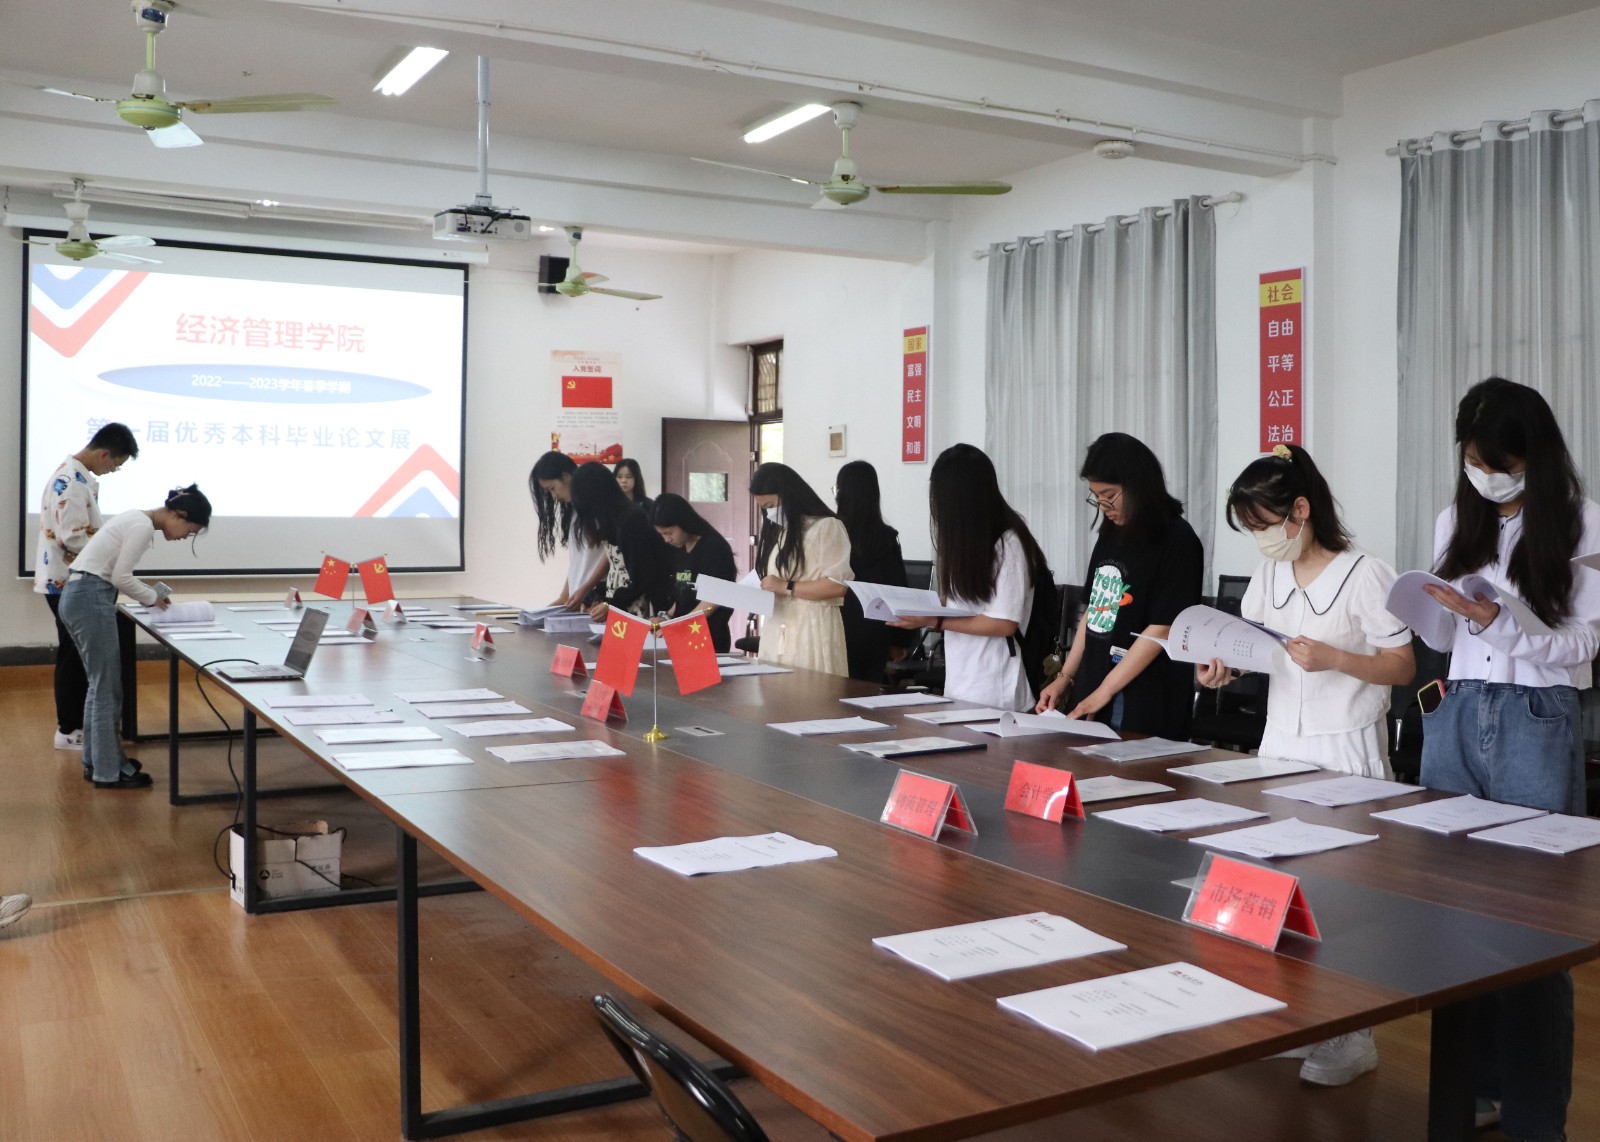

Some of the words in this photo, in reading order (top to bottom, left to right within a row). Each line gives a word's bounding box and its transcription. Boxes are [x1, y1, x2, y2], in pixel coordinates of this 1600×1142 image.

[1267, 283, 1294, 303] 社会
[175, 313, 366, 353] 经济管理学院
[1267, 318, 1294, 338] 自由
[907, 338, 922, 351] 国家
[907, 363, 922, 377] 富强
[1267, 353, 1294, 373] 平等
[907, 389, 922, 403] 民主
[1267, 389, 1294, 408] 公正
[906, 415, 921, 429] 文明
[1267, 424, 1294, 443] 法治
[906, 441, 921, 455] 和谐
[1210, 882, 1277, 920] 市场营销
